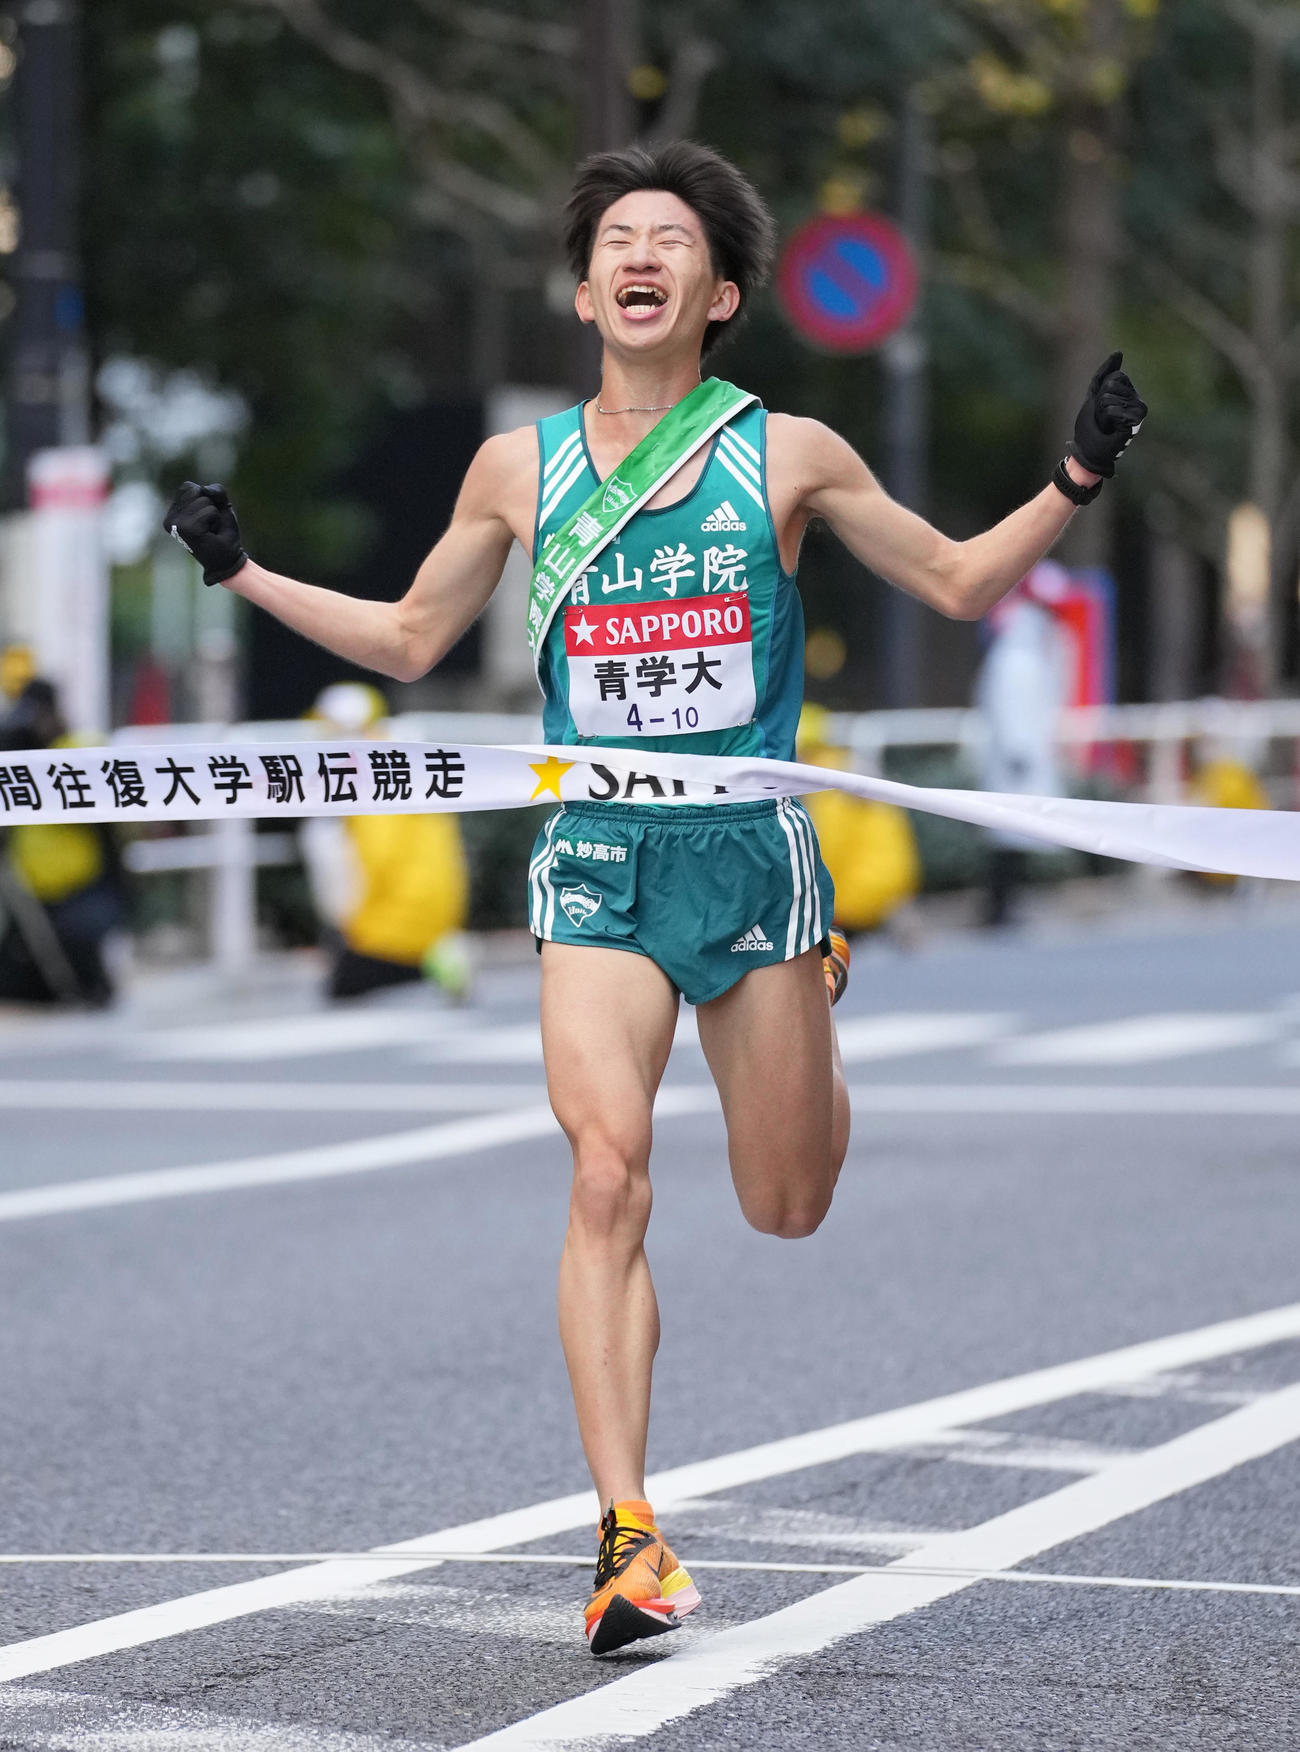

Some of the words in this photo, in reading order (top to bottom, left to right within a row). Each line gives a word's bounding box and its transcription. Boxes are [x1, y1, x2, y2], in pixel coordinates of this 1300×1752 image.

[701, 519, 747, 532] adidas
[606, 606, 743, 645] SAPPORO
[595, 652, 723, 701] 青学大
[576, 841, 628, 862] 妙高市
[731, 940, 774, 952] adidas
